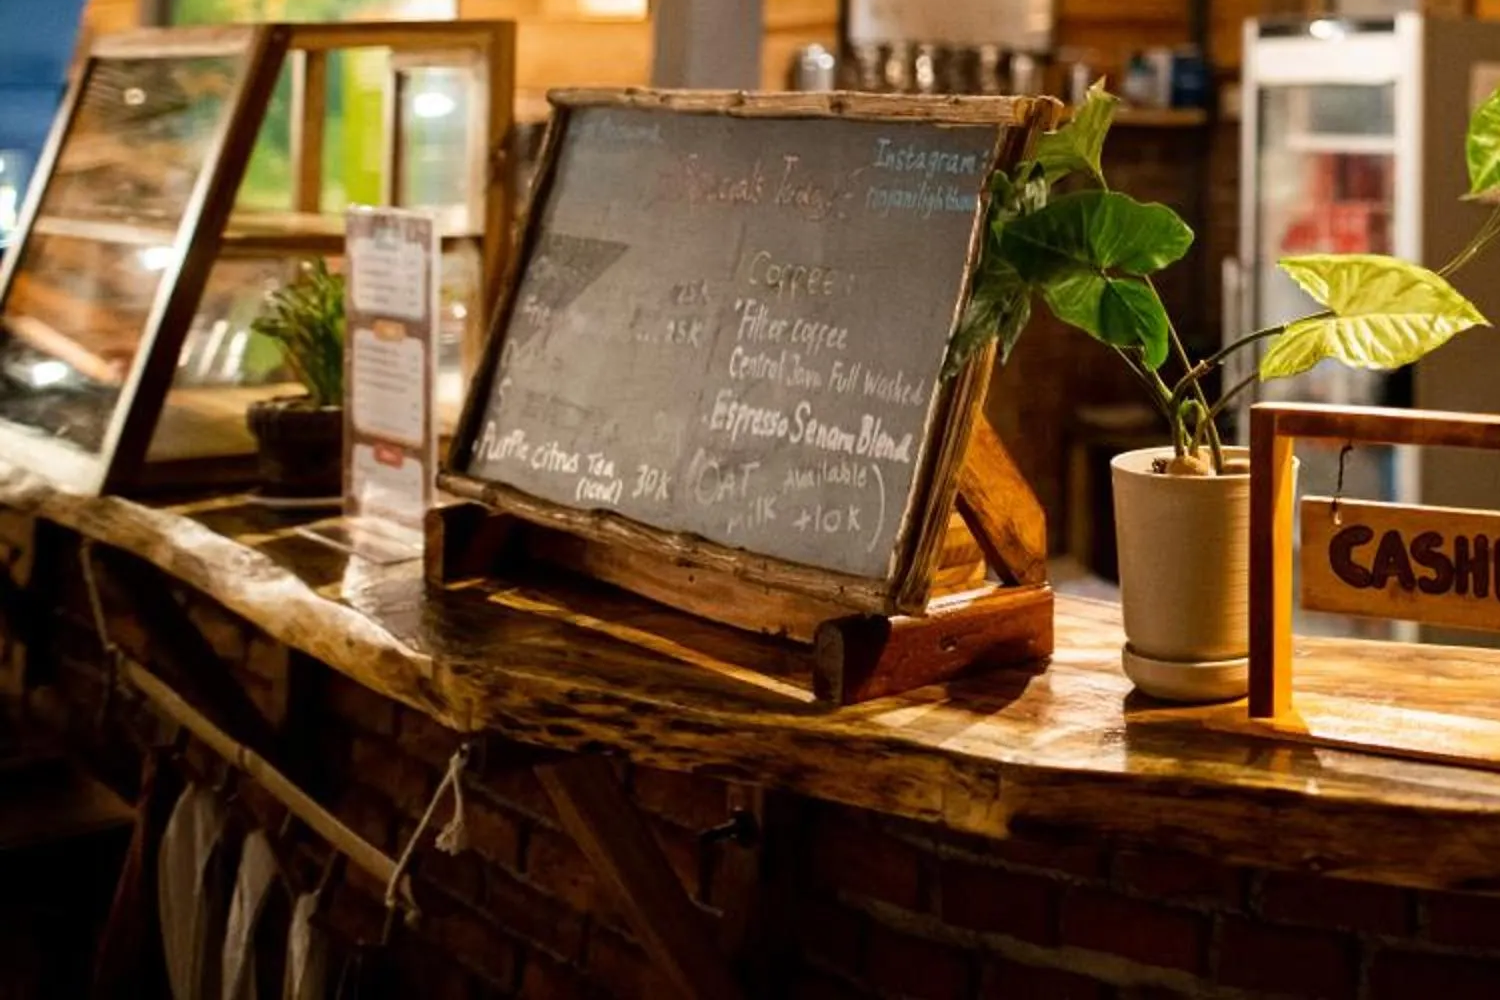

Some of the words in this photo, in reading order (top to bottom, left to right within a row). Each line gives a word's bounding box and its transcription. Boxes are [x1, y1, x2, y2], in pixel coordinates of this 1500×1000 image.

[828, 359, 863, 394] Full
[710, 389, 790, 442] Espresso
[855, 413, 914, 465] Blend
